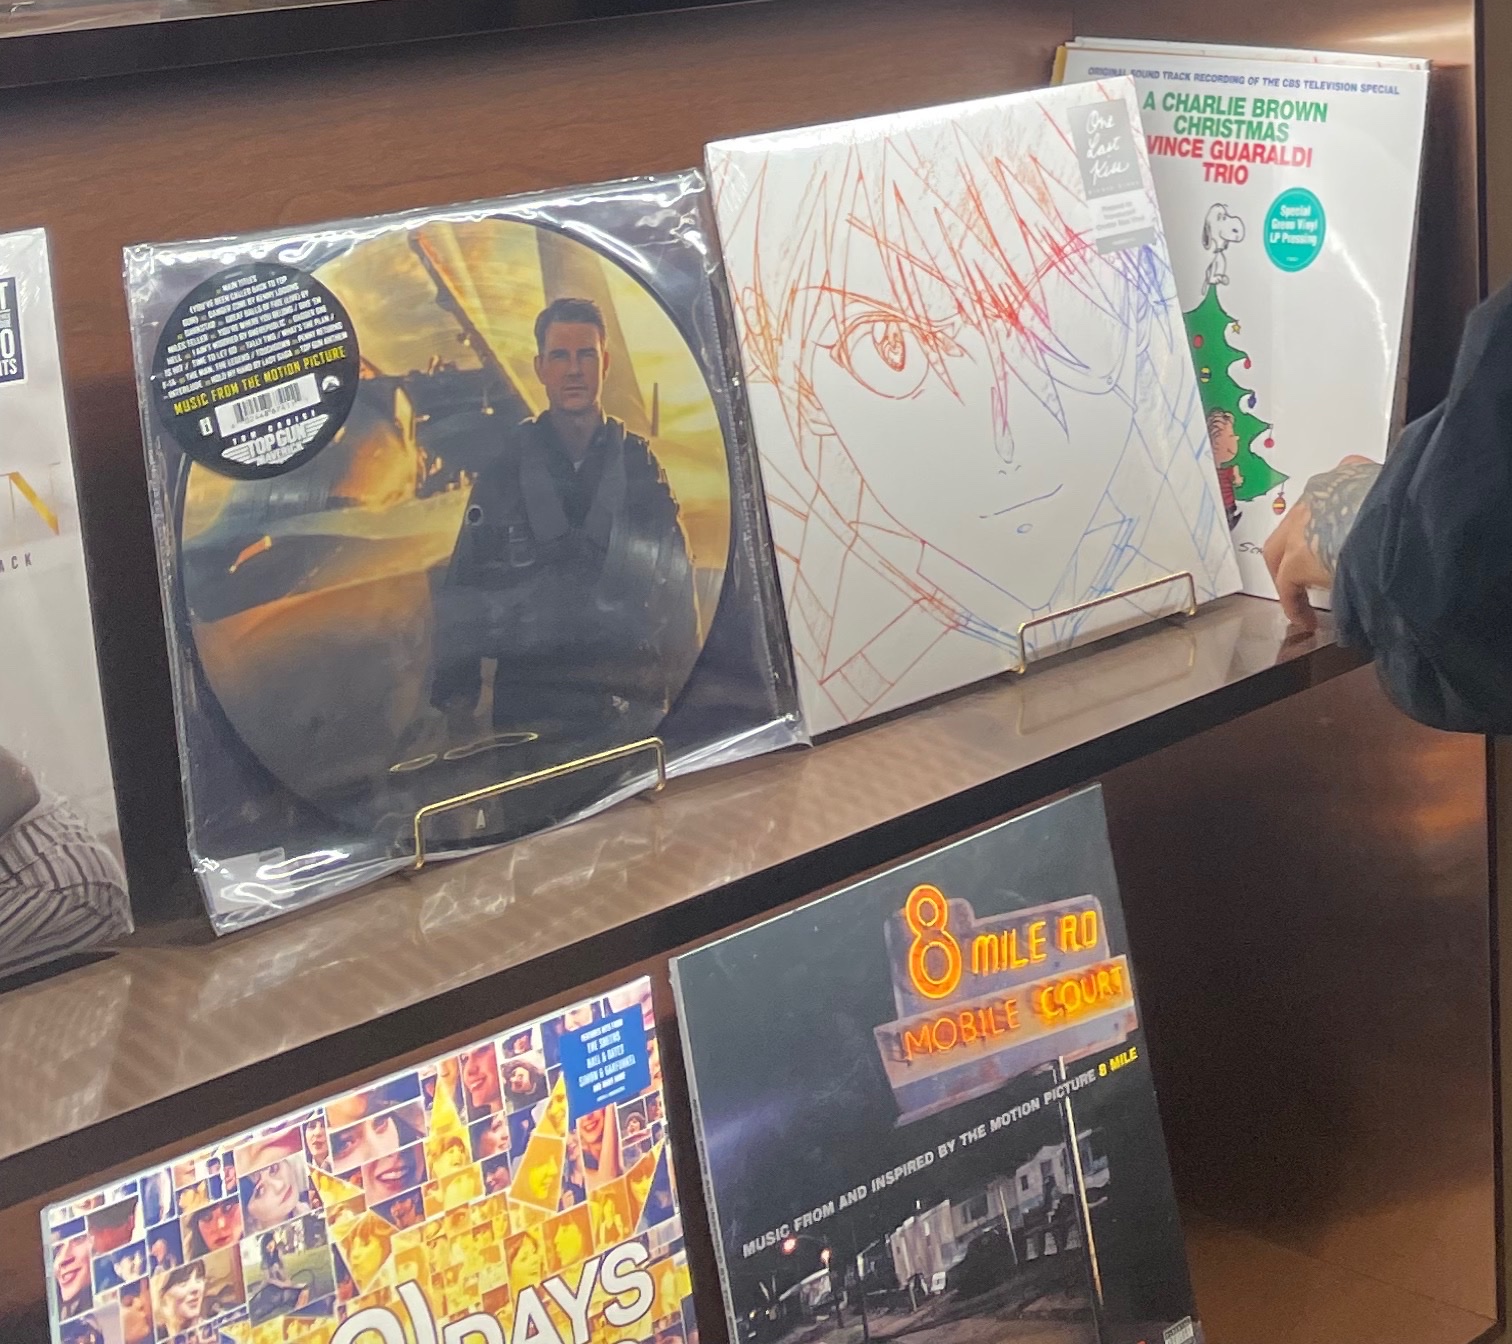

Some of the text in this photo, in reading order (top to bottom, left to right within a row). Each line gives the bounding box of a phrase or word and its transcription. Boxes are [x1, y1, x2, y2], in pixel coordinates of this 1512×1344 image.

[1130, 69, 1160, 79] SOUND
[1162, 71, 1191, 82] TRACK
[1193, 72, 1245, 85] RECORDING
[1247, 76, 1260, 86] OF
[1262, 77, 1280, 88] THE
[1282, 78, 1300, 89] CBS
[1303, 79, 1358, 93] TELEVISION
[1360, 84, 1400, 95] SPECIAL
[1142, 90, 1328, 123] A CHARLIE BROWN
[1086, 110, 1115, 135] One
[1173, 115, 1290, 143] CHRISTMAS
[1087, 133, 1121, 159] Last
[1146, 135, 1313, 168] VINCE GUARALDI
[1090, 162, 1129, 186] Kiss
[1202, 162, 1249, 185] TRIO
[1271, 218, 1318, 232] Green Vinyl
[1280, 205, 1311, 219] Special
[1270, 232, 1317, 246] LP Pressing
[173, 392, 210, 416] MUSIC
[211, 382, 239, 402] FROM
[242, 373, 261, 391] THE
[263, 361, 301, 383] MOTION
[303, 345, 347, 369] PICTURE
[248, 424, 308, 457] TOP GUN
[905, 884, 1098, 1000] 8 MILE RD
[904, 966, 1125, 1063] MOBILE COURT
[742, 1046, 1139, 1259] MUSIC FROM AND INSPIRED BY THE MOTION PICTURE 8 MILE
